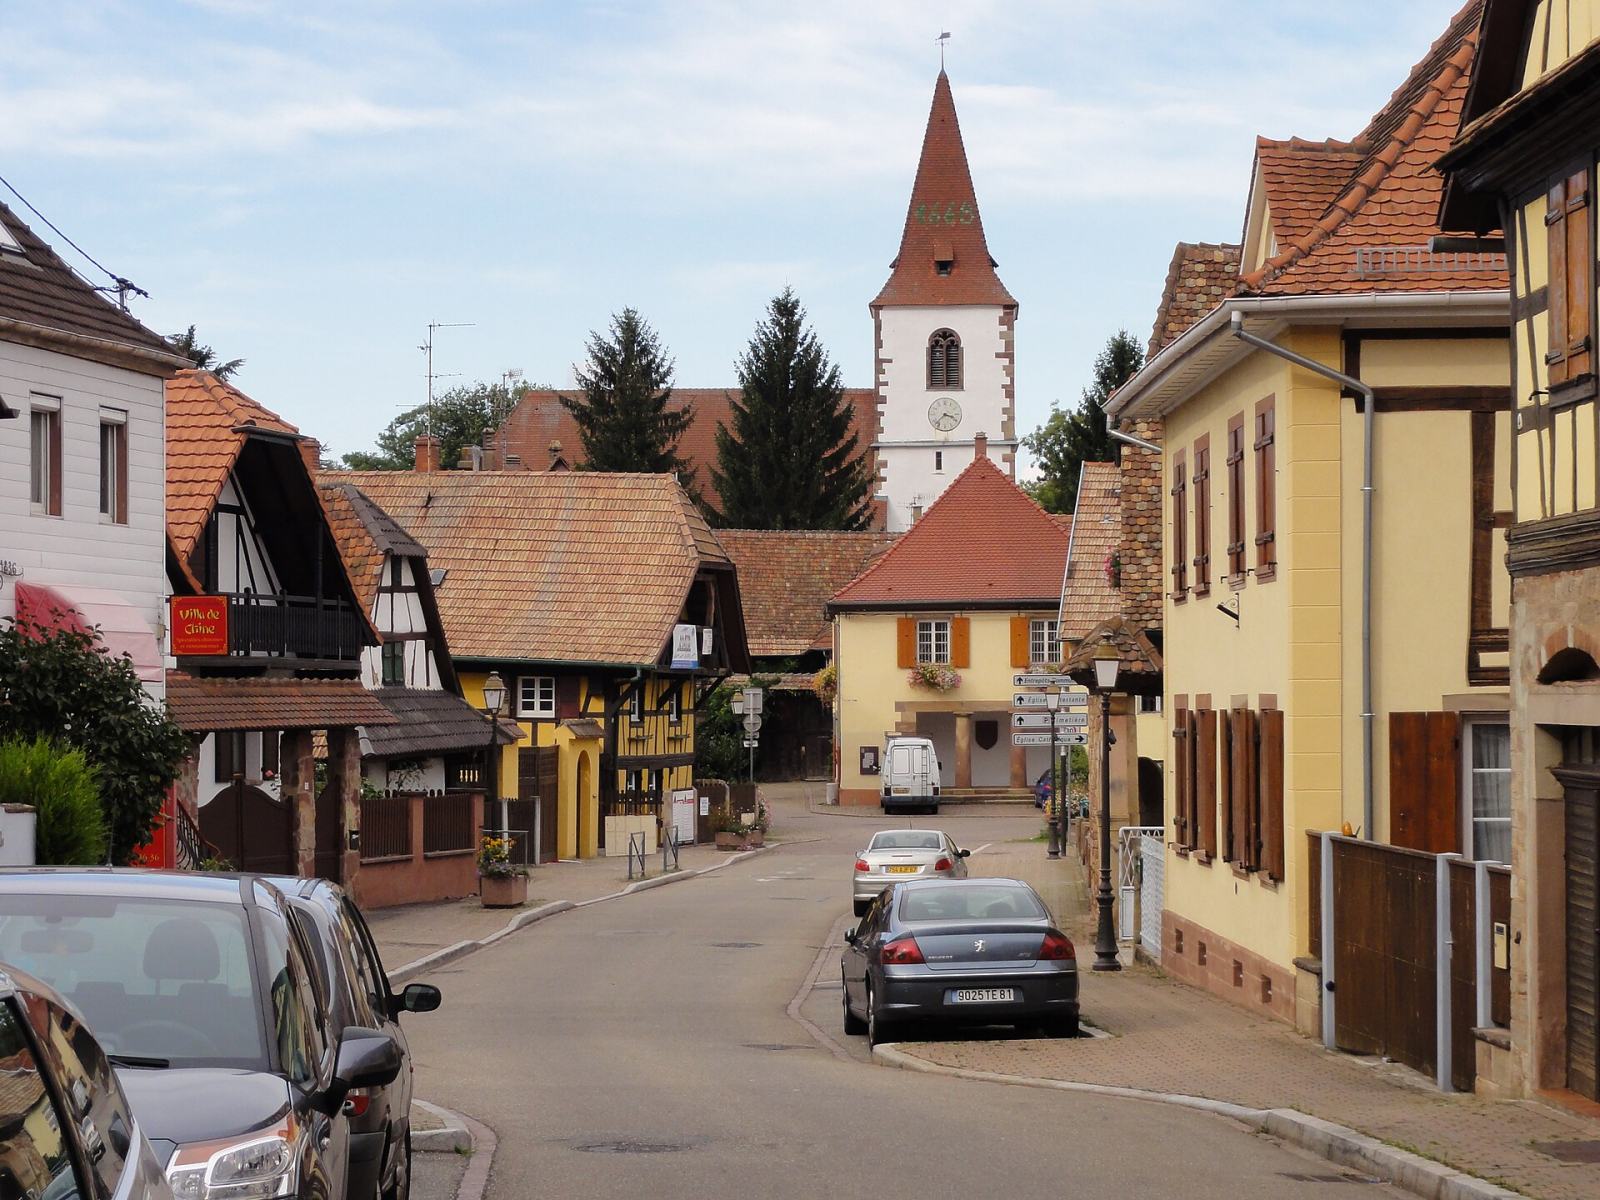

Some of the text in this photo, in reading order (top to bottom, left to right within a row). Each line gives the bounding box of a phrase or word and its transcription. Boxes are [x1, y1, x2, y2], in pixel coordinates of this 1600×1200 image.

[179, 608, 220, 620] Villa de
[184, 622, 215, 635] Chine
